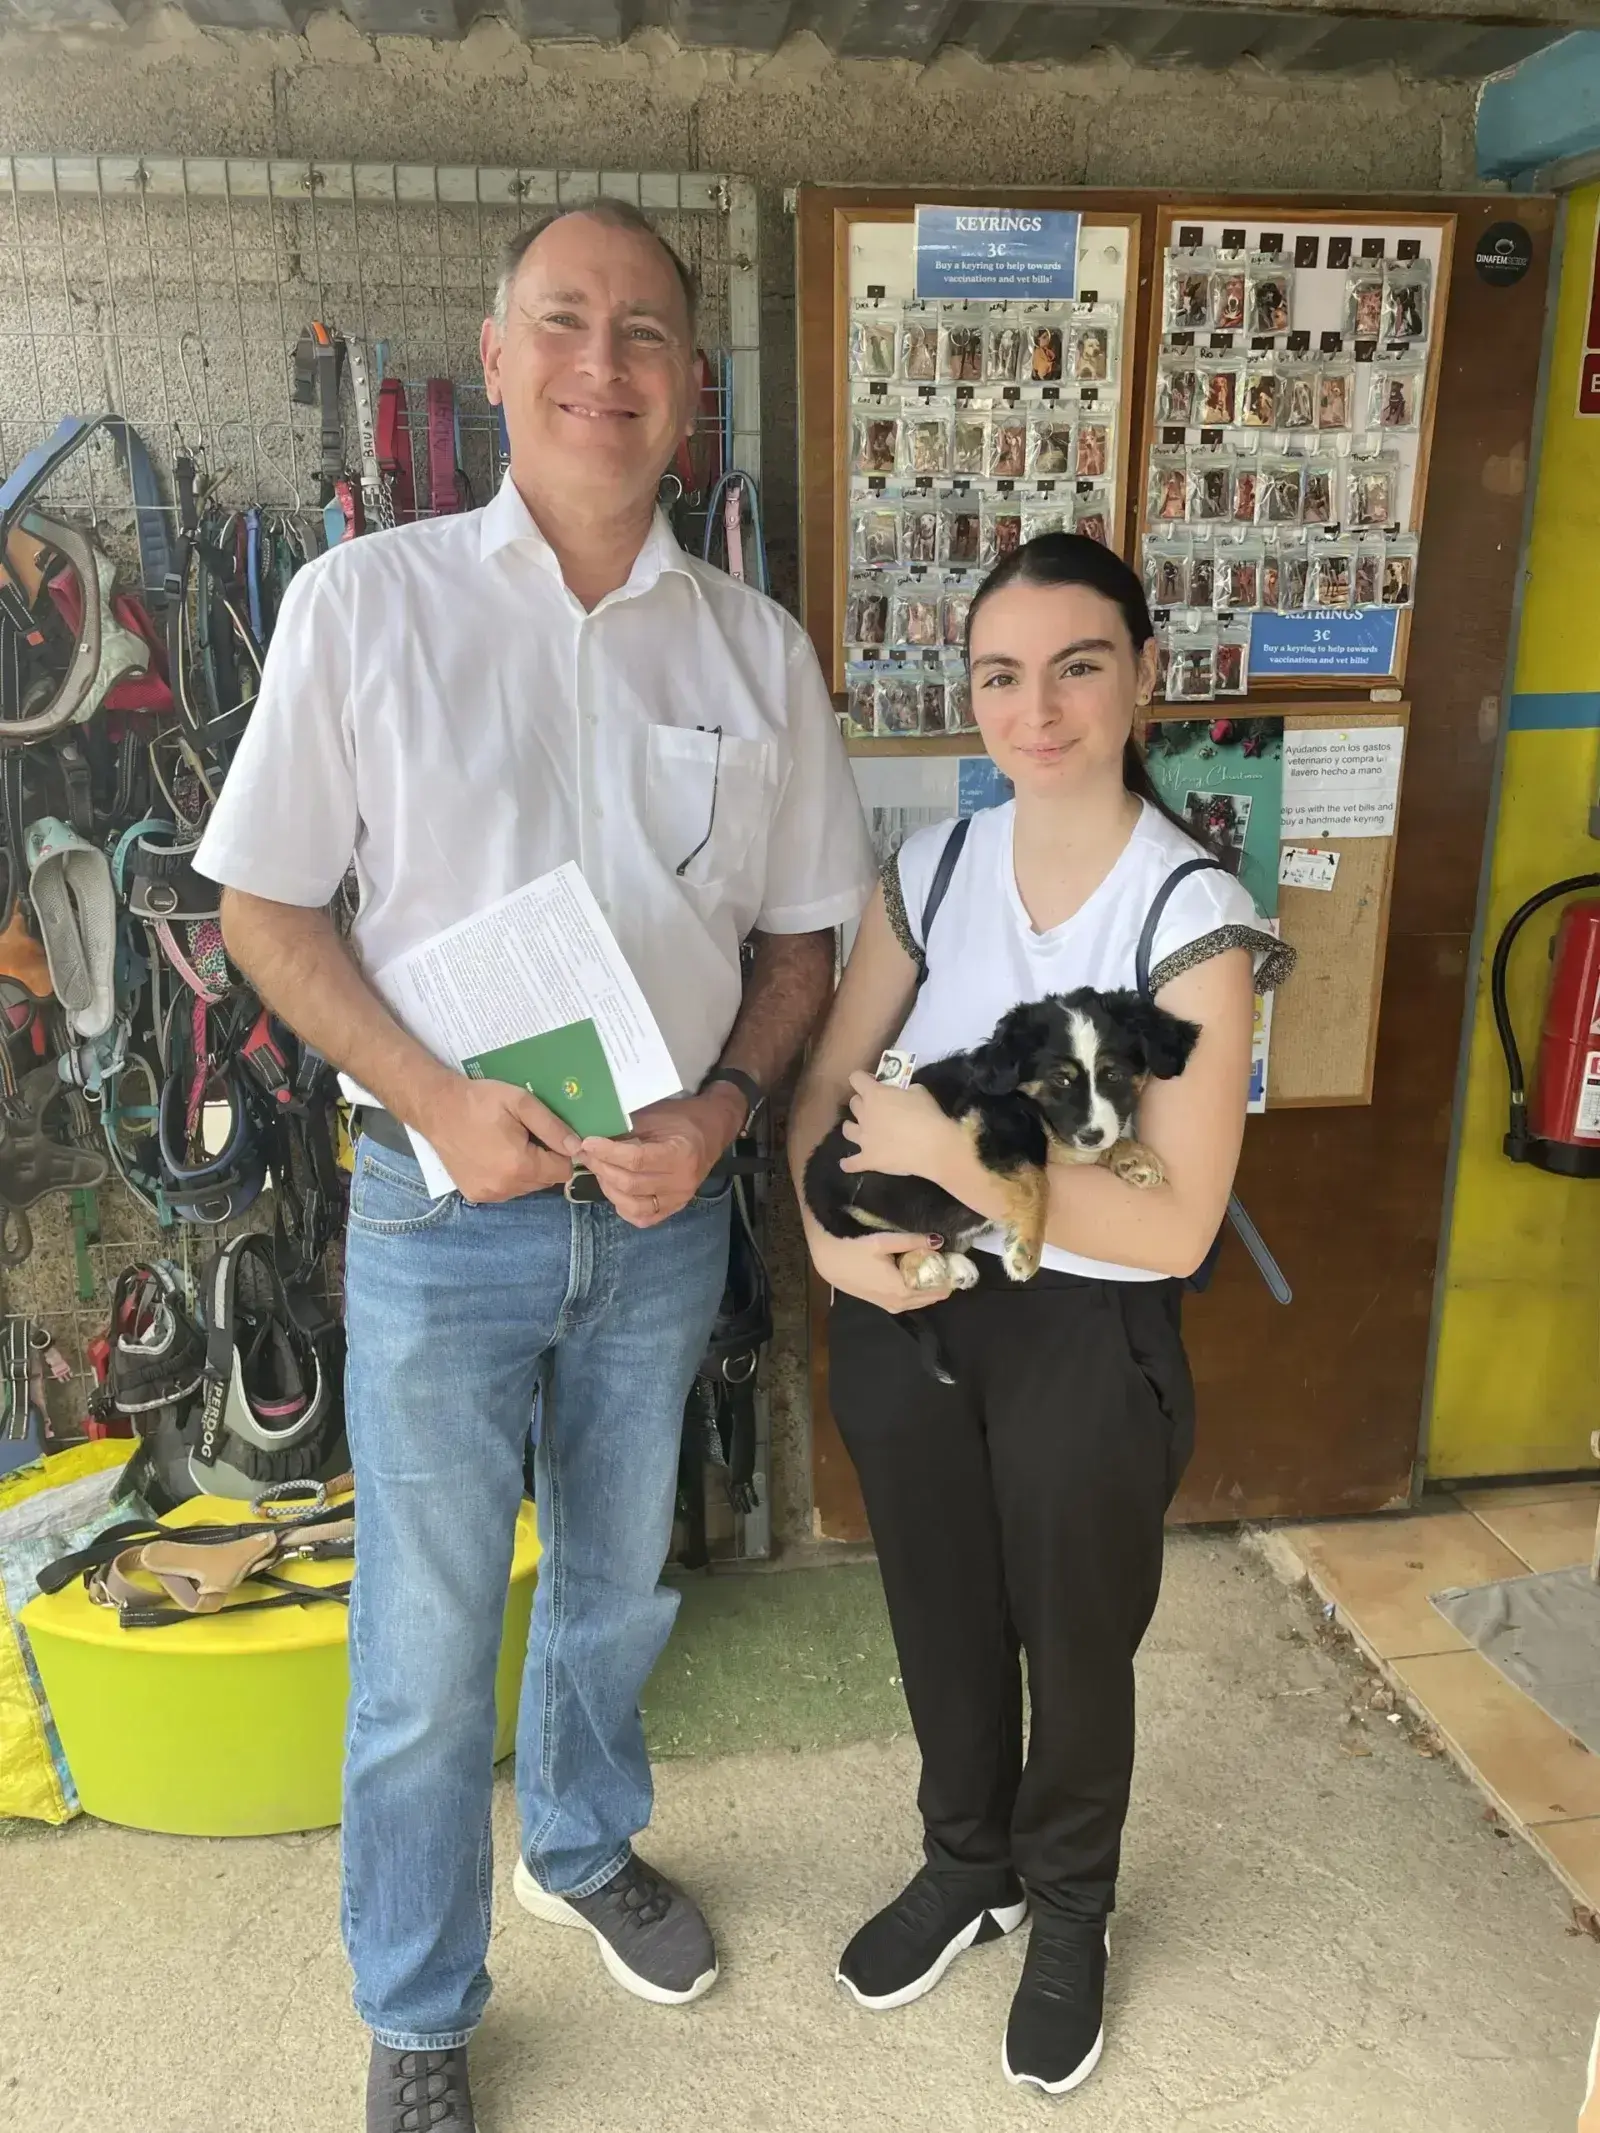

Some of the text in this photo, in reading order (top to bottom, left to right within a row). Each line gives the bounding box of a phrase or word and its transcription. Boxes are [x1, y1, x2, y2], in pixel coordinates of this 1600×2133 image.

[955, 217, 1042, 232] KEYRINGS
[935, 261, 952, 271] Buy
[962, 261, 994, 271] keyring
[996, 262, 1005, 270] to
[1006, 262, 1025, 271] help
[1027, 262, 1061, 270] towards
[944, 275, 1053, 284] vaccinations and vet bills!
[1312, 629, 1331, 642] 3€
[1263, 644, 1279, 653] Buy
[1287, 644, 1316, 653] keyring
[1328, 645, 1345, 653] help
[1347, 645, 1378, 653] towards
[1269, 656, 1318, 664] vaccinations
[1319, 656, 1334, 664] and
[1350, 656, 1369, 664] bills!
[1348, 744, 1360, 752] los
[1363, 744, 1391, 753] gastos
[1287, 757, 1332, 765] veterinario
[1342, 756, 1374, 765] compra
[1291, 768, 1319, 777] llavero
[1321, 767, 1348, 776] hecho
[1358, 767, 1382, 775] mano
[1280, 803, 1394, 815] elp us with the vet bills and
[1306, 816, 1351, 824] handmade
[1353, 815, 1385, 824] keyring
[201, 1381, 224, 1458] PERDOG
